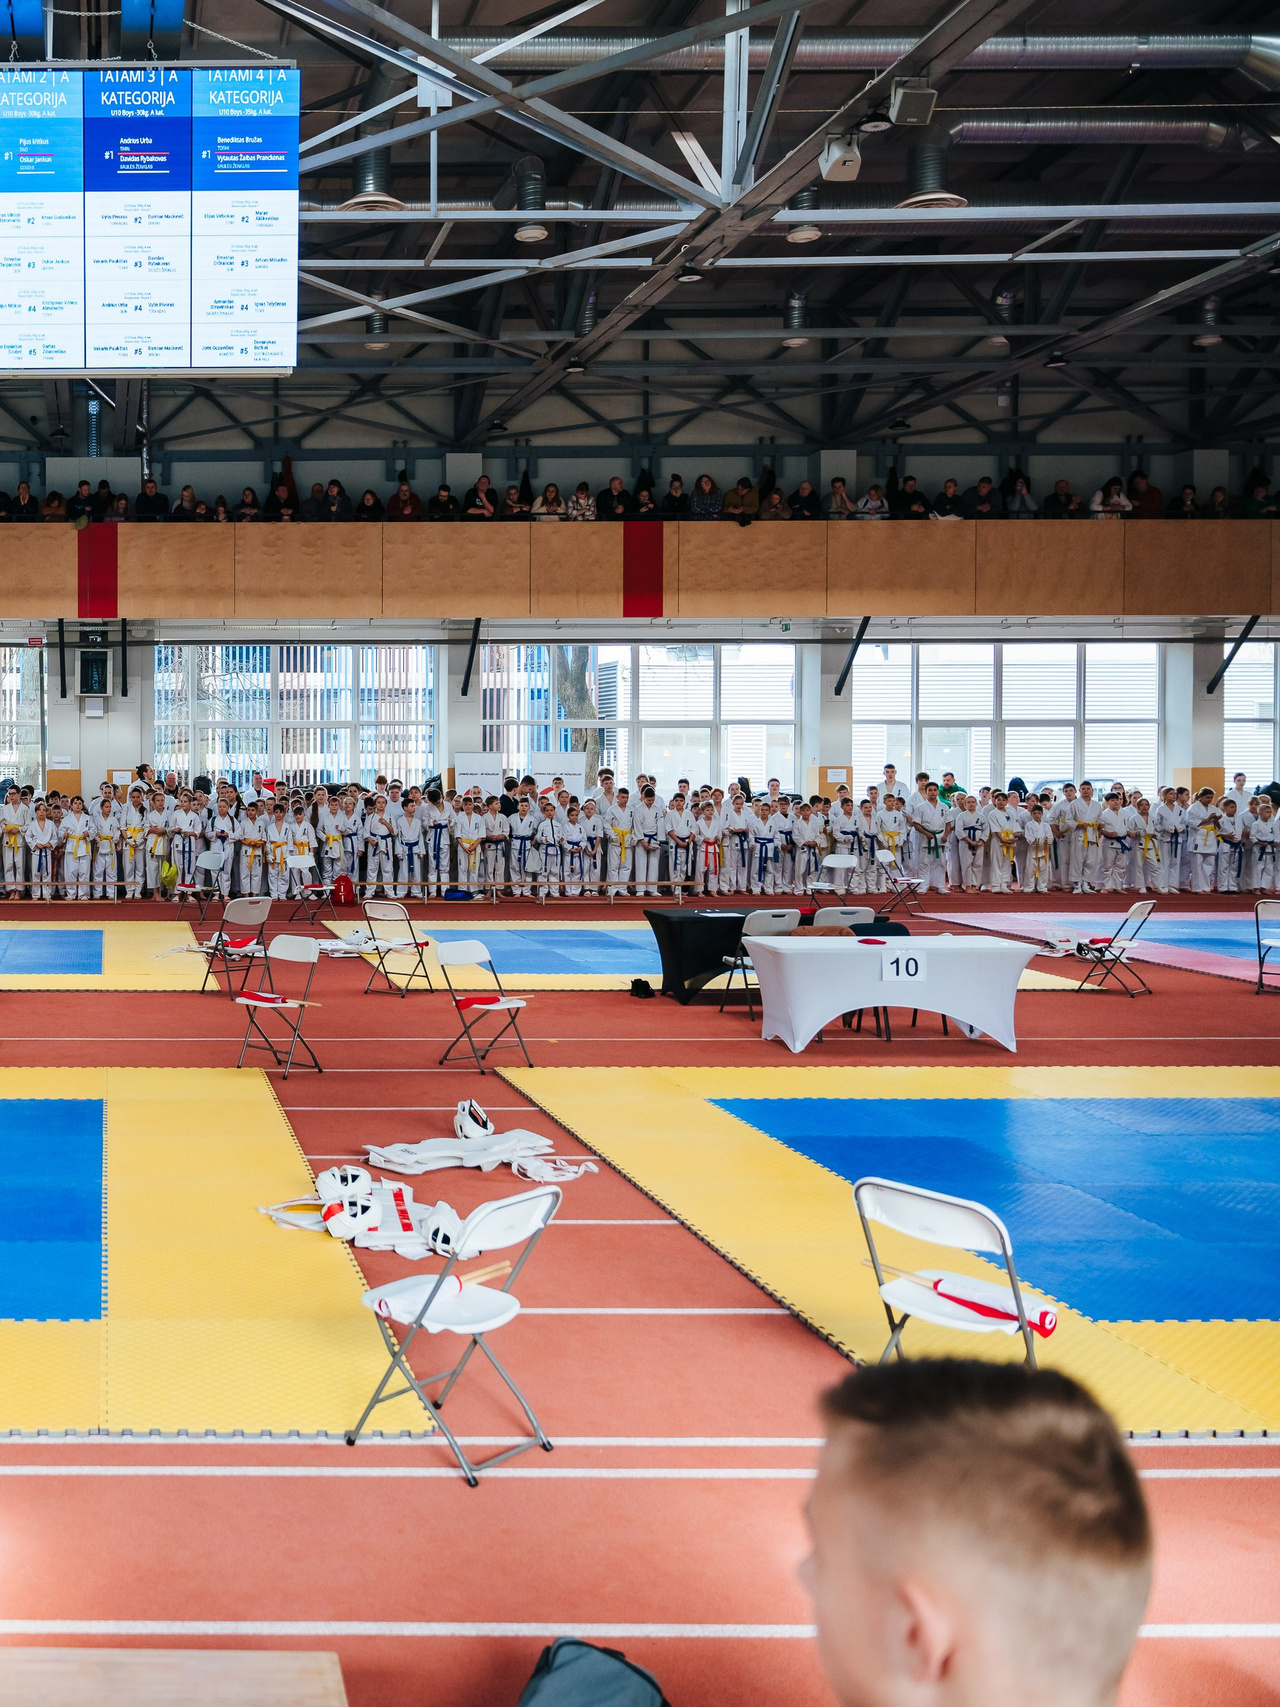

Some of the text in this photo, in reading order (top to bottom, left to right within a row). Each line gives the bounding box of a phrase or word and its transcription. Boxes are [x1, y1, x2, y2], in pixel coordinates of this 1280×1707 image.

[61, 72, 69, 83] A
[169, 70, 178, 82] A
[277, 70, 286, 82] A
[101, 92, 175, 107] KATEGORIJA
[210, 90, 283, 106] KATEGORIJA
[4, 152, 13, 160] #1
[104, 151, 113, 159] #1
[202, 150, 210, 158] #1
[890, 957, 918, 977] 10
